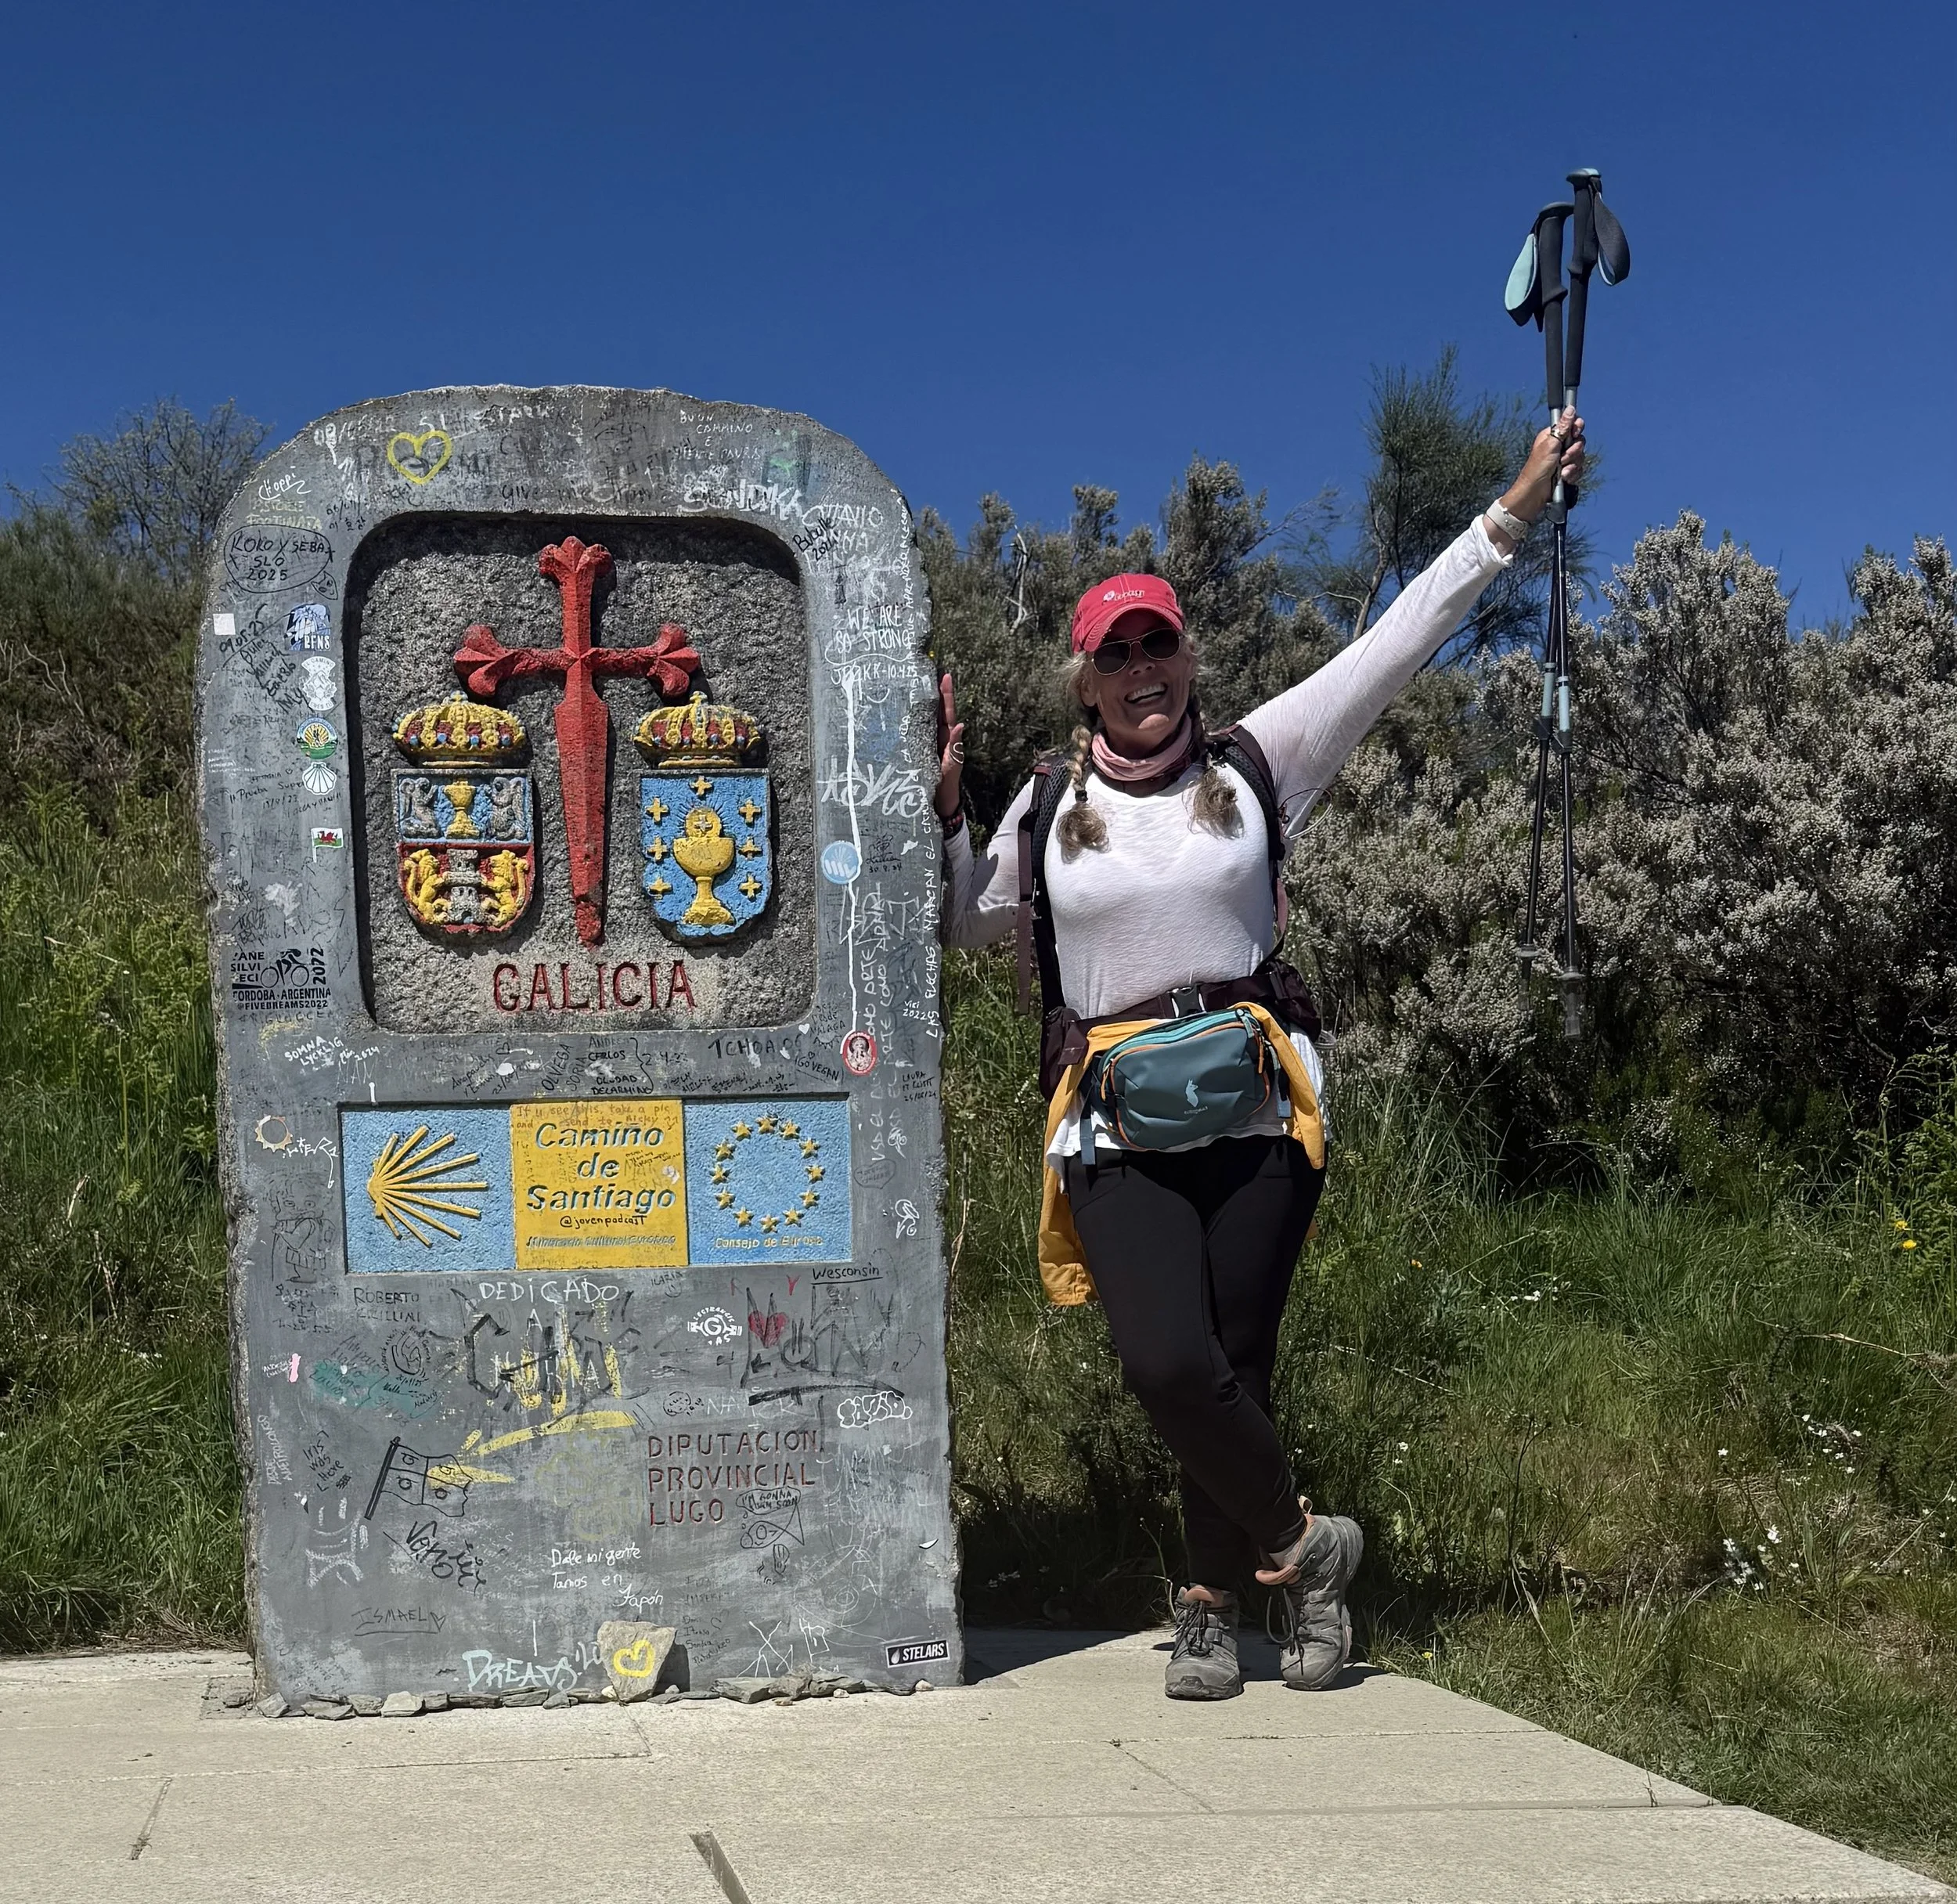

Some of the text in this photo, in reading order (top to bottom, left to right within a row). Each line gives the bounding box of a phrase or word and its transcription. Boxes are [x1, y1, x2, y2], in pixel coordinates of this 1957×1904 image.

[247, 568, 289, 581] 2025
[280, 987, 332, 1001] ARGENTINA
[492, 960, 697, 1012] GALICIA
[576, 1151, 621, 1179] de
[526, 1182, 677, 1214] Santiago
[715, 1236, 761, 1250] Consejo
[763, 1236, 778, 1247] de
[811, 1261, 881, 1282] Wesconsin
[353, 1286, 420, 1306] ROBERTO
[478, 1277, 620, 1304] DEDICADO
[647, 1430, 818, 1459] DIPUTACION
[647, 1462, 816, 1494] PROVINCIAL
[649, 1498, 724, 1527] LUGO
[903, 1643, 945, 1661] STELARS
